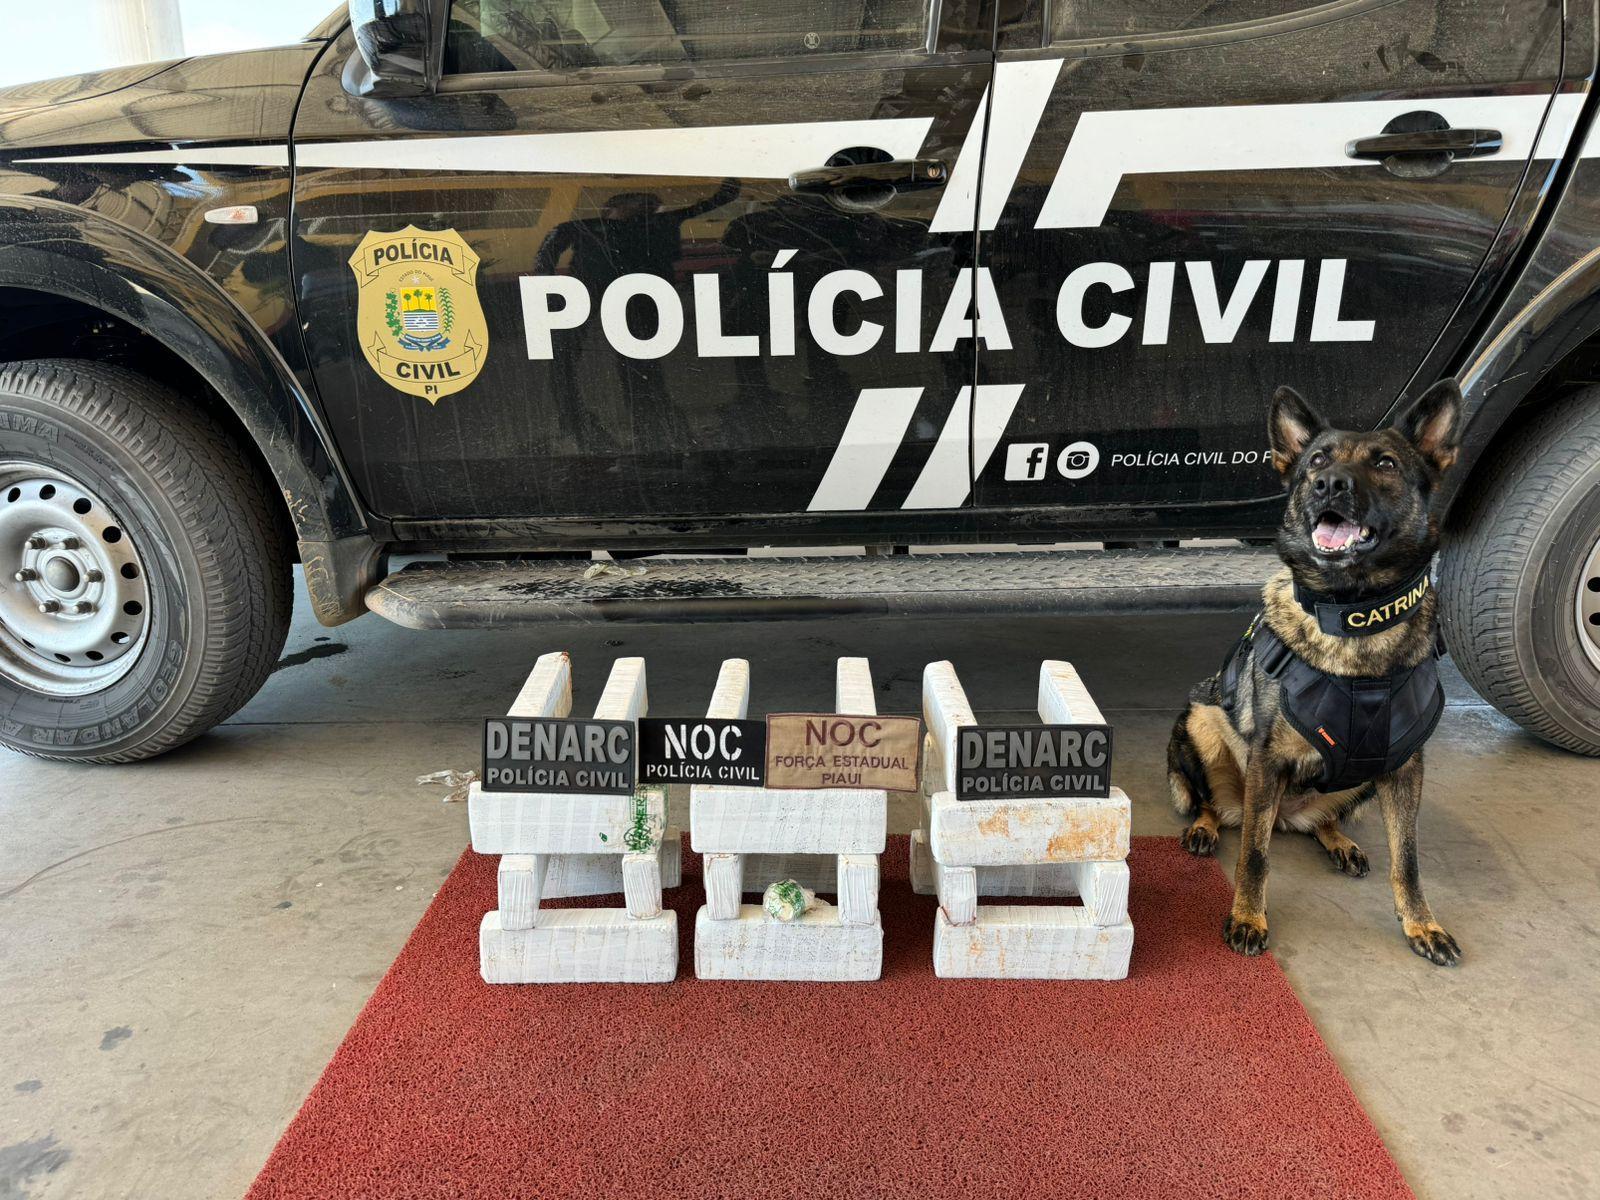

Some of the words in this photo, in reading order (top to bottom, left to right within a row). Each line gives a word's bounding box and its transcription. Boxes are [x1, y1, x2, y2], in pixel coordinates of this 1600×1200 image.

[373, 238, 453, 265] POLÍCIA
[519, 249, 1014, 362] POLÍCIA
[1056, 257, 1378, 349] CIVIL
[396, 361, 461, 379] CIVIL
[425, 384, 438, 395] PI
[1111, 450, 1180, 467] POLÍCIA
[1184, 451, 1227, 465] CIVIL
[1231, 450, 1258, 464] DO
[1347, 575, 1429, 628] CATRINA
[486, 721, 630, 764] DENARC
[663, 724, 743, 761] NOC
[804, 719, 882, 748] NOC
[961, 730, 1108, 770] DENARC
[646, 762, 713, 780] POLÍCIA
[718, 766, 760, 781] CIVIL
[775, 755, 826, 771] FORÇA
[833, 755, 910, 770] ESTADUAL
[487, 766, 570, 787] POLÍCIA
[575, 770, 629, 789] CIVIL
[821, 772, 862, 785] PIAUI
[962, 774, 1045, 793] POLÍCIA
[1050, 773, 1104, 792] CIVIL
